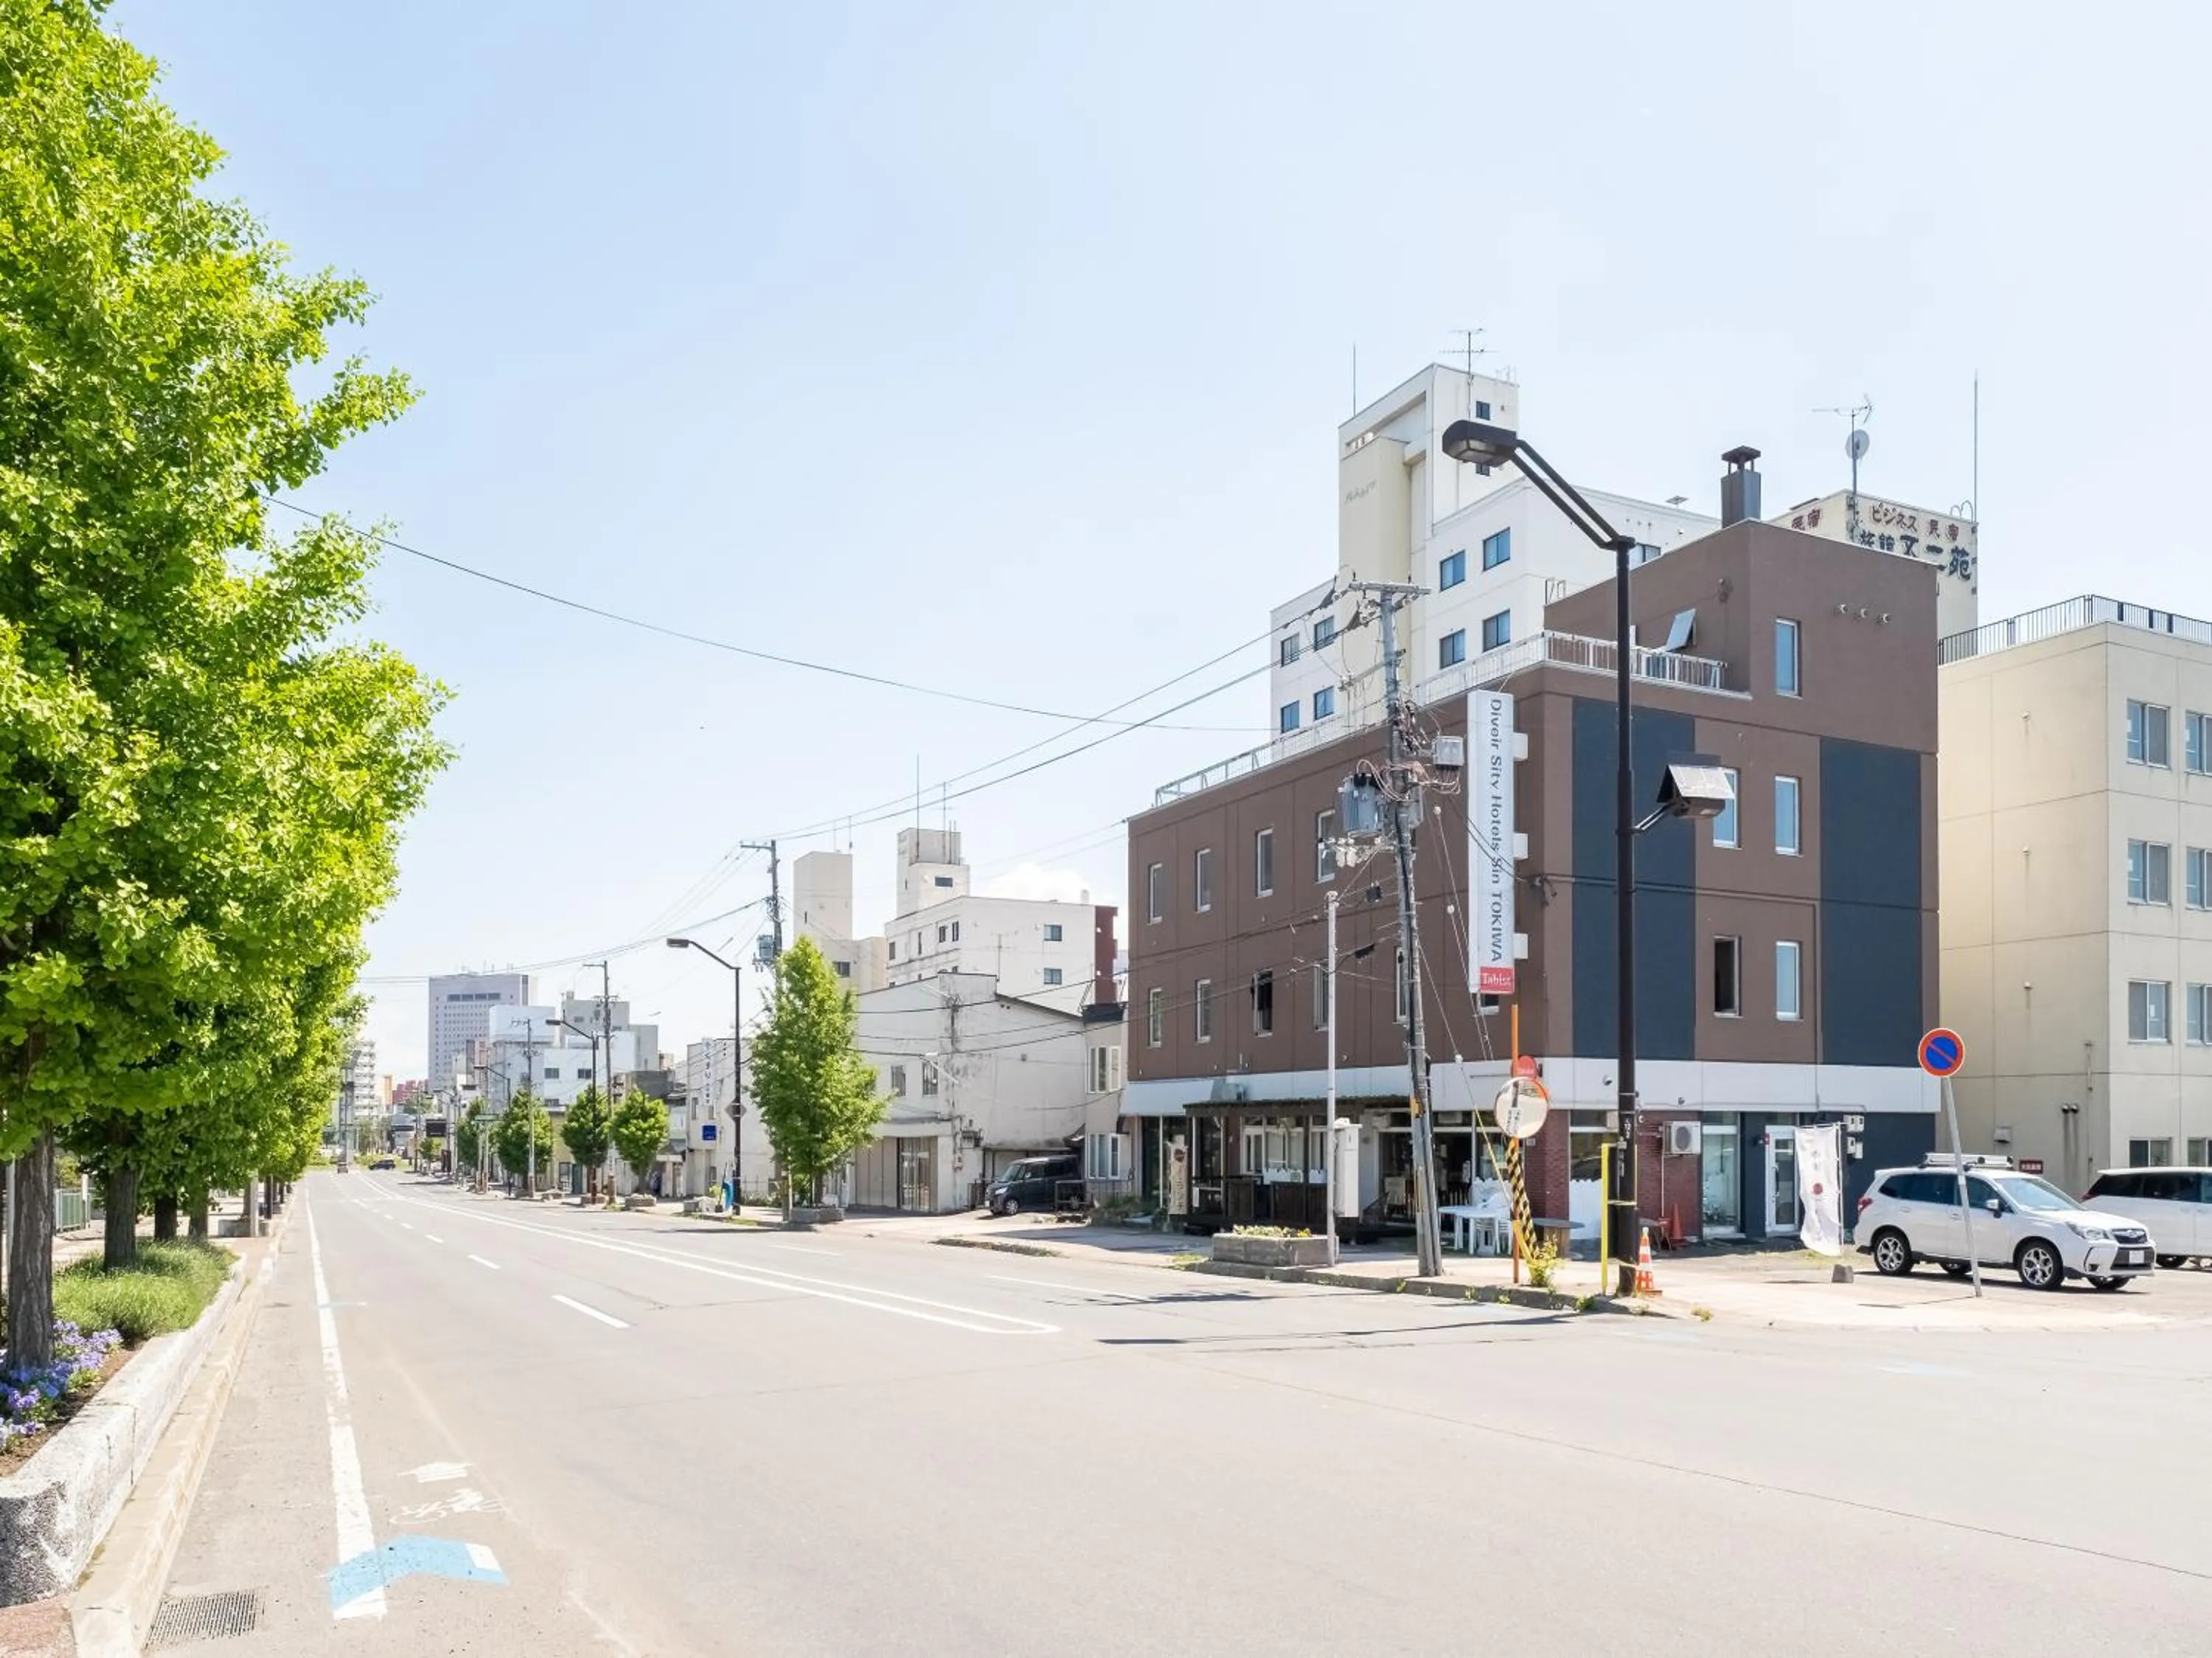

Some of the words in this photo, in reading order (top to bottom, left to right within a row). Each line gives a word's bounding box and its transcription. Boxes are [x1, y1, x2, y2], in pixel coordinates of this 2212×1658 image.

[1489, 755, 1502, 792] Sity
[1491, 794, 1503, 851] Hotels
[1491, 890, 1503, 962] TOKIWA
